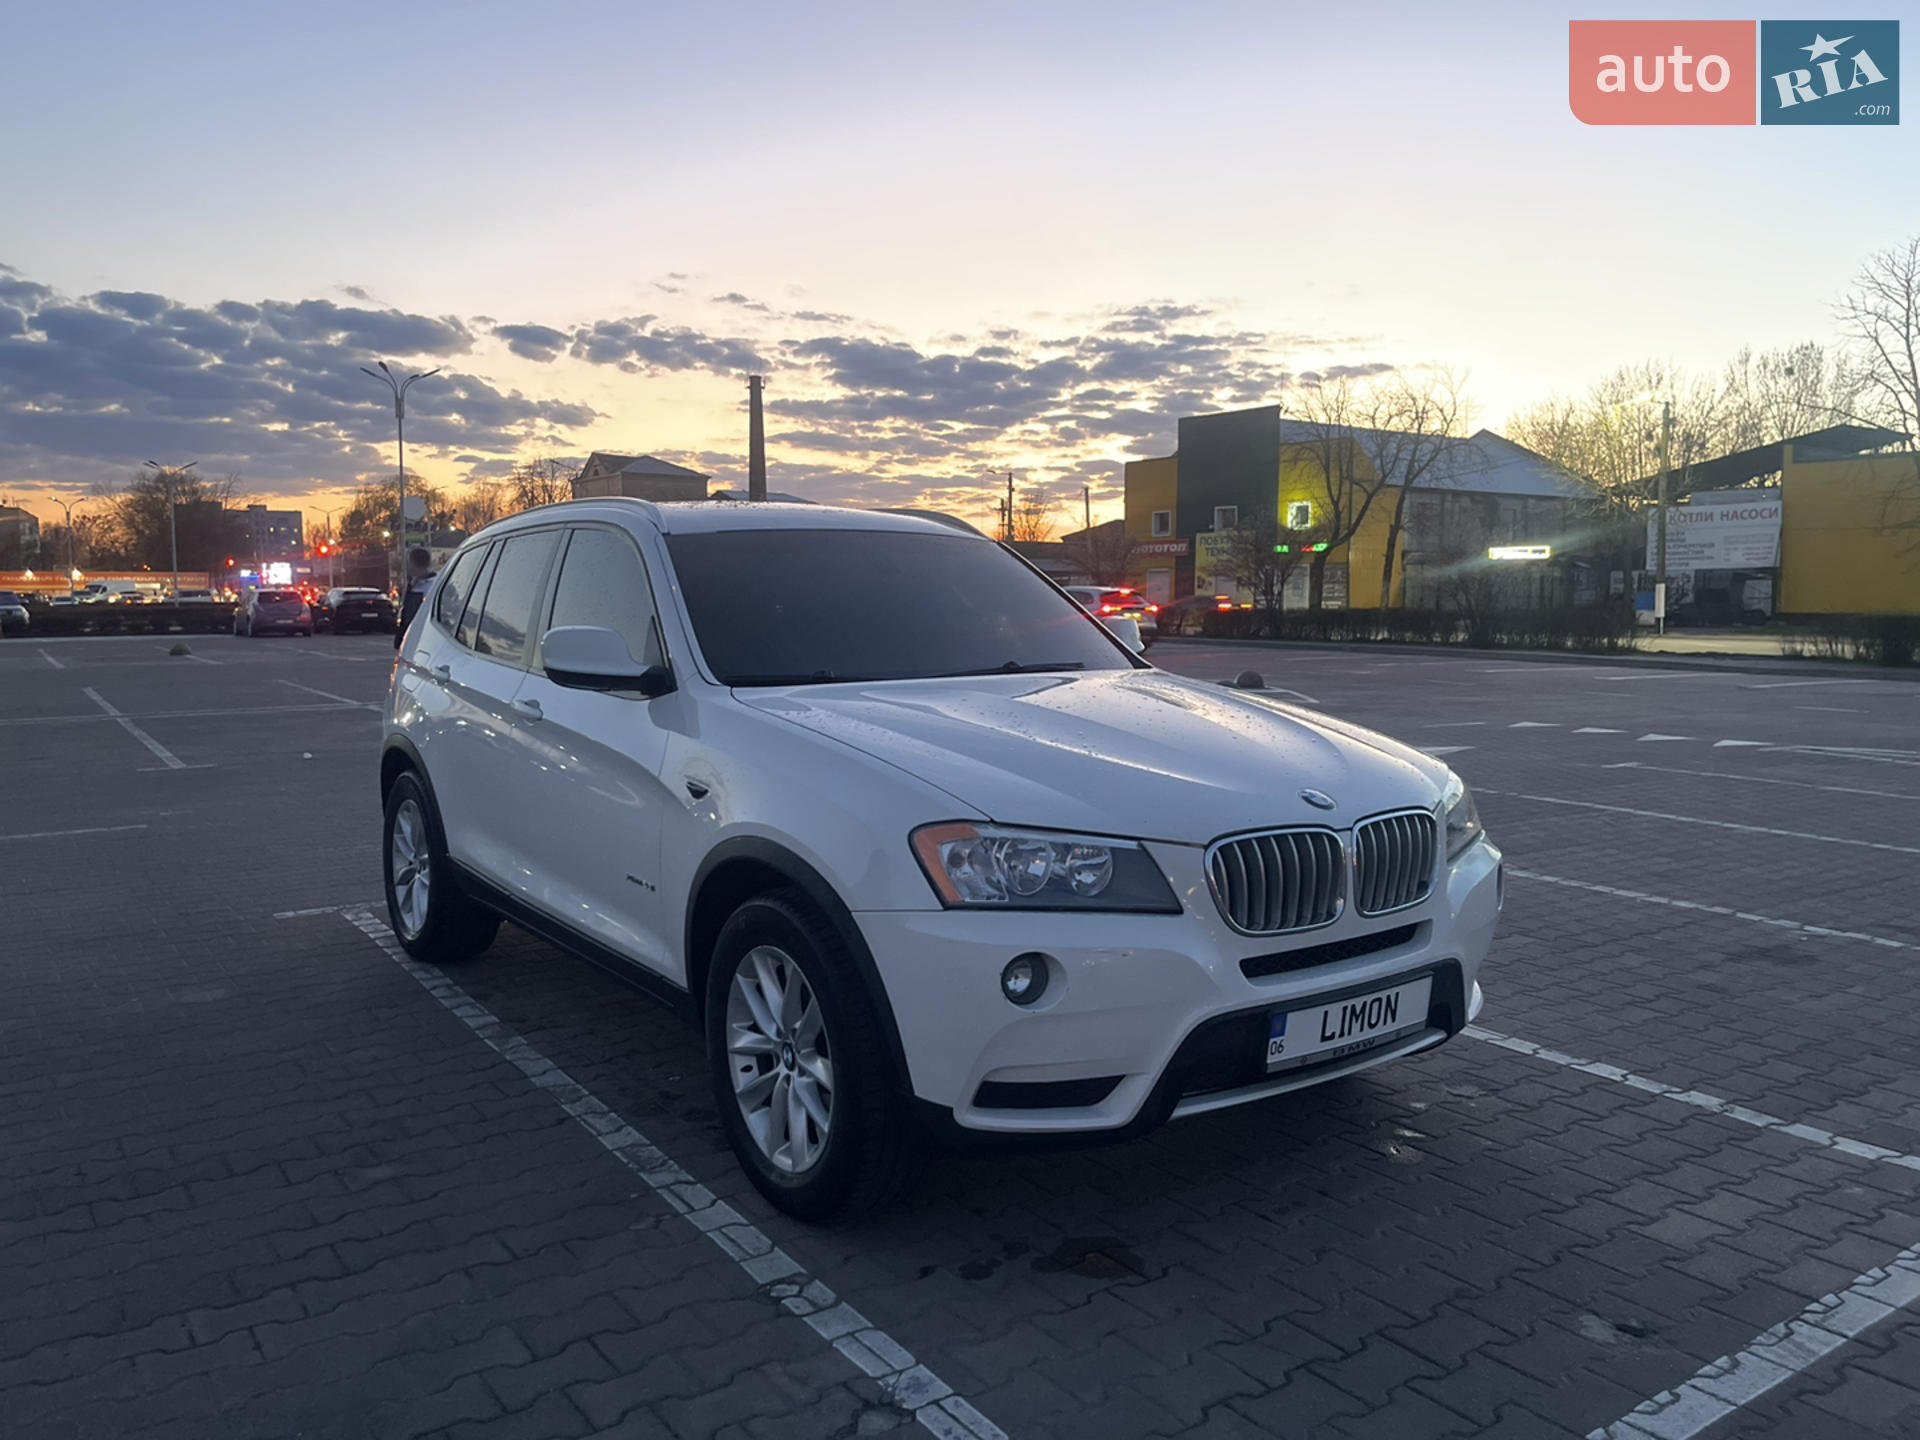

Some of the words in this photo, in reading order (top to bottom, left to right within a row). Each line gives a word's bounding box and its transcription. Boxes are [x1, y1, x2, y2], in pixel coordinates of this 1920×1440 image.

[1668, 511, 1714, 525] КОТЛИ
[1720, 507, 1779, 521] НАСОСИ
[1319, 991, 1400, 1043] LIMON
[1270, 1038, 1285, 1056] 06
